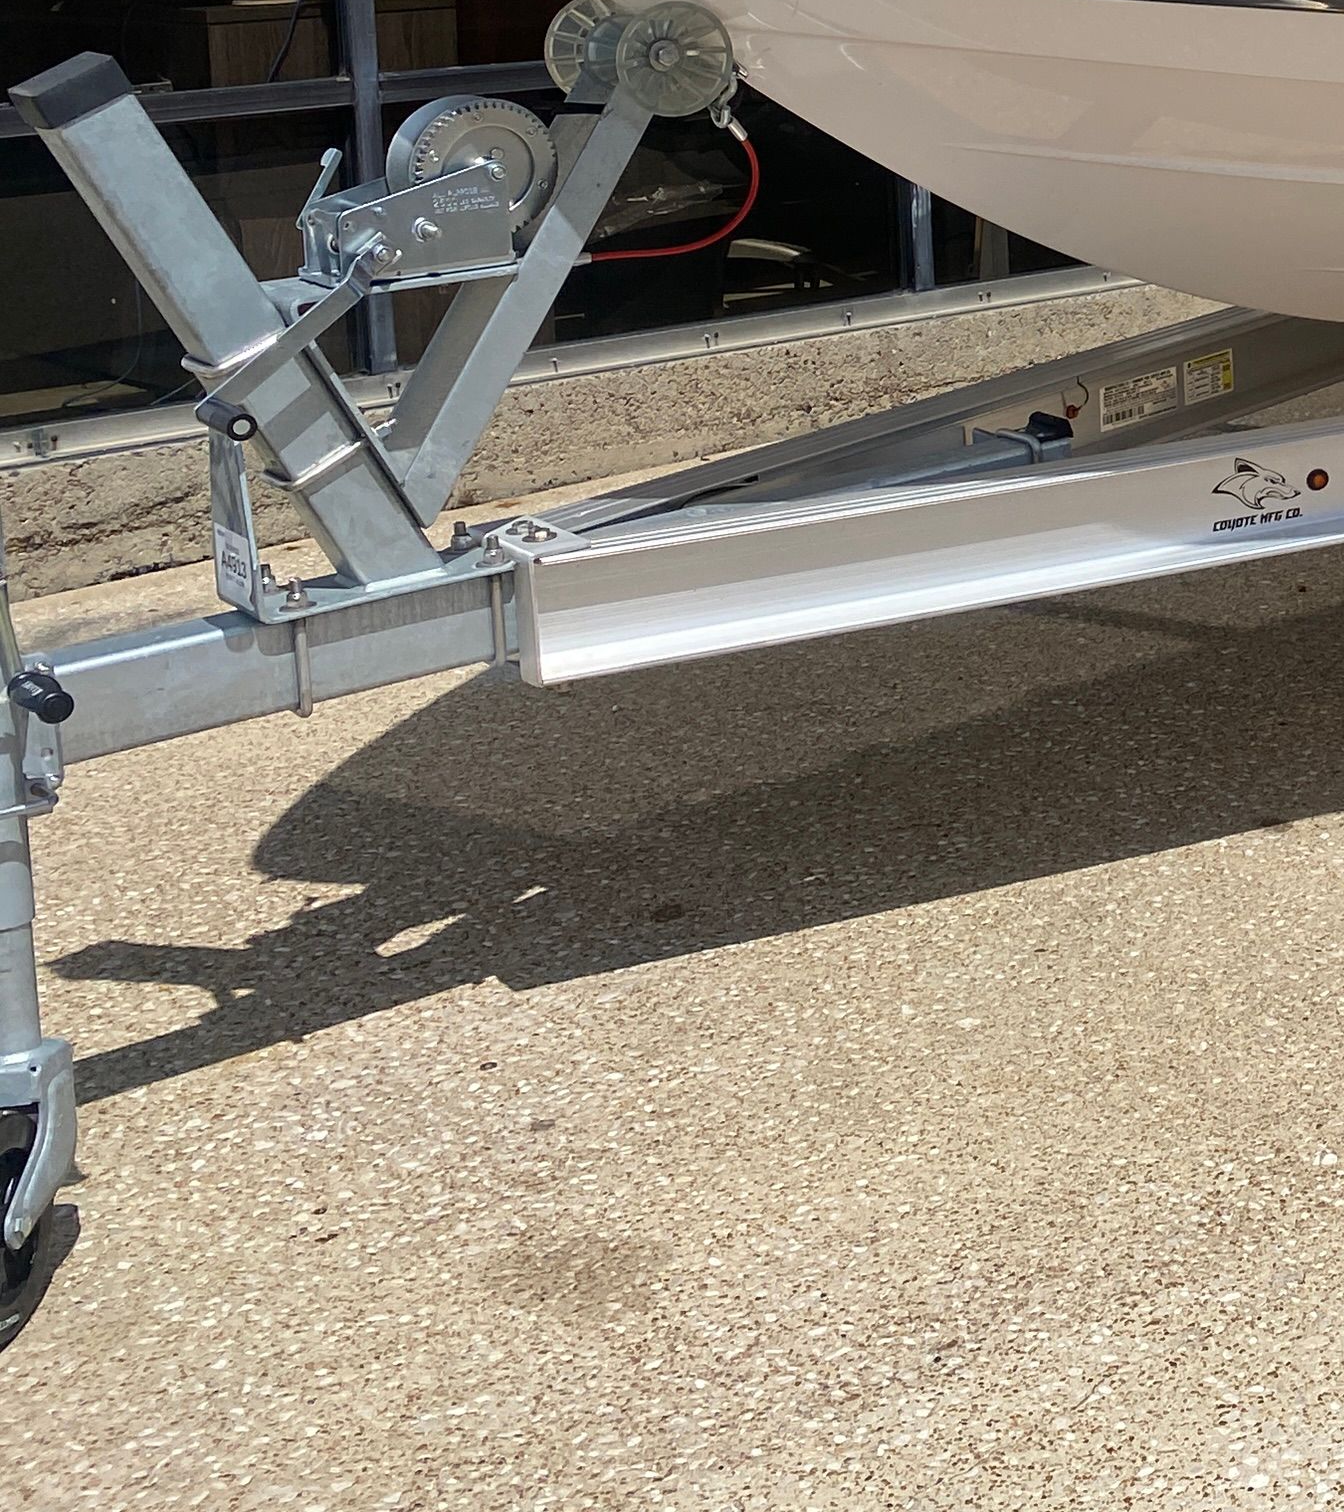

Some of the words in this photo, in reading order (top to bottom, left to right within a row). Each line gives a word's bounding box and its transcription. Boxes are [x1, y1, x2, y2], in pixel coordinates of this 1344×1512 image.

[1212, 514, 1258, 532] COYOTE
[1260, 510, 1283, 524] MFG
[1286, 507, 1303, 519] CO.
